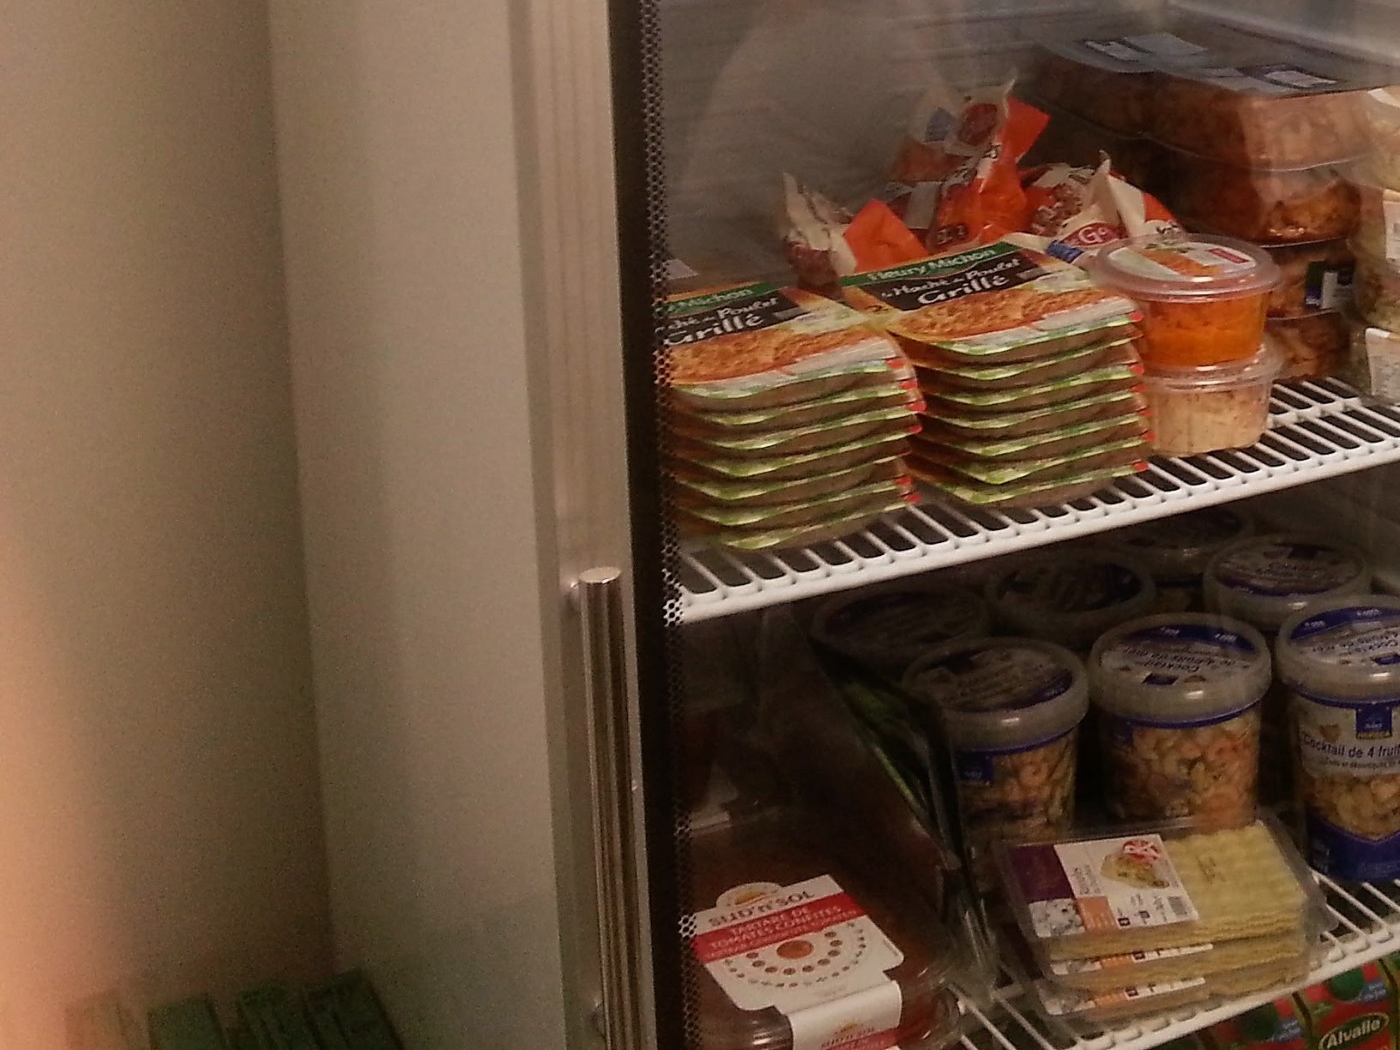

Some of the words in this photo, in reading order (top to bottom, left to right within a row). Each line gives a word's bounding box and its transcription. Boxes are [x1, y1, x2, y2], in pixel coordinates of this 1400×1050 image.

[927, 249, 997, 271] Michon
[965, 258, 1022, 281] Poulet
[916, 274, 1011, 305] Grillé
[1303, 732, 1346, 757] Cocktail
[1348, 746, 1363, 759] de
[1366, 746, 1375, 758] 4
[1326, 1019, 1382, 1050] Alvalle
